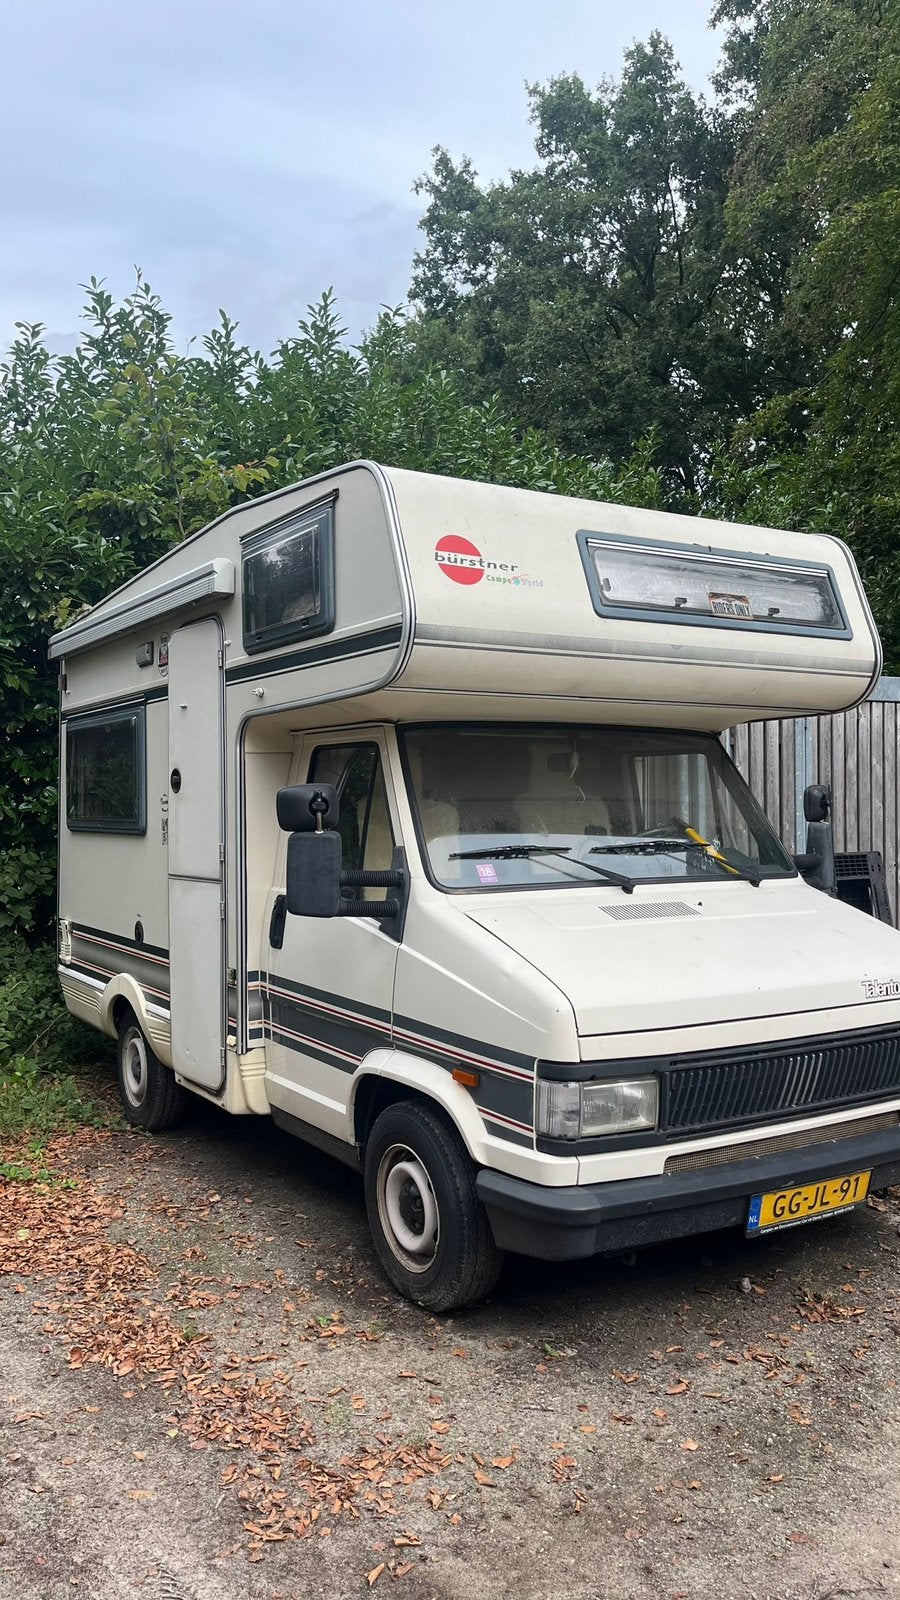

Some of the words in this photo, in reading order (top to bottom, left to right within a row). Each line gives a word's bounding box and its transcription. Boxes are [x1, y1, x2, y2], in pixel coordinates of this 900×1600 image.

[434, 552, 519, 572] bürstner
[711, 601, 735, 615] RIDERS
[735, 603, 751, 617] ONLY
[479, 867, 493, 877] 18
[861, 979, 900, 999] Talento
[772, 1176, 861, 1218] GG-JL-91
[748, 1215, 758, 1224] NL
